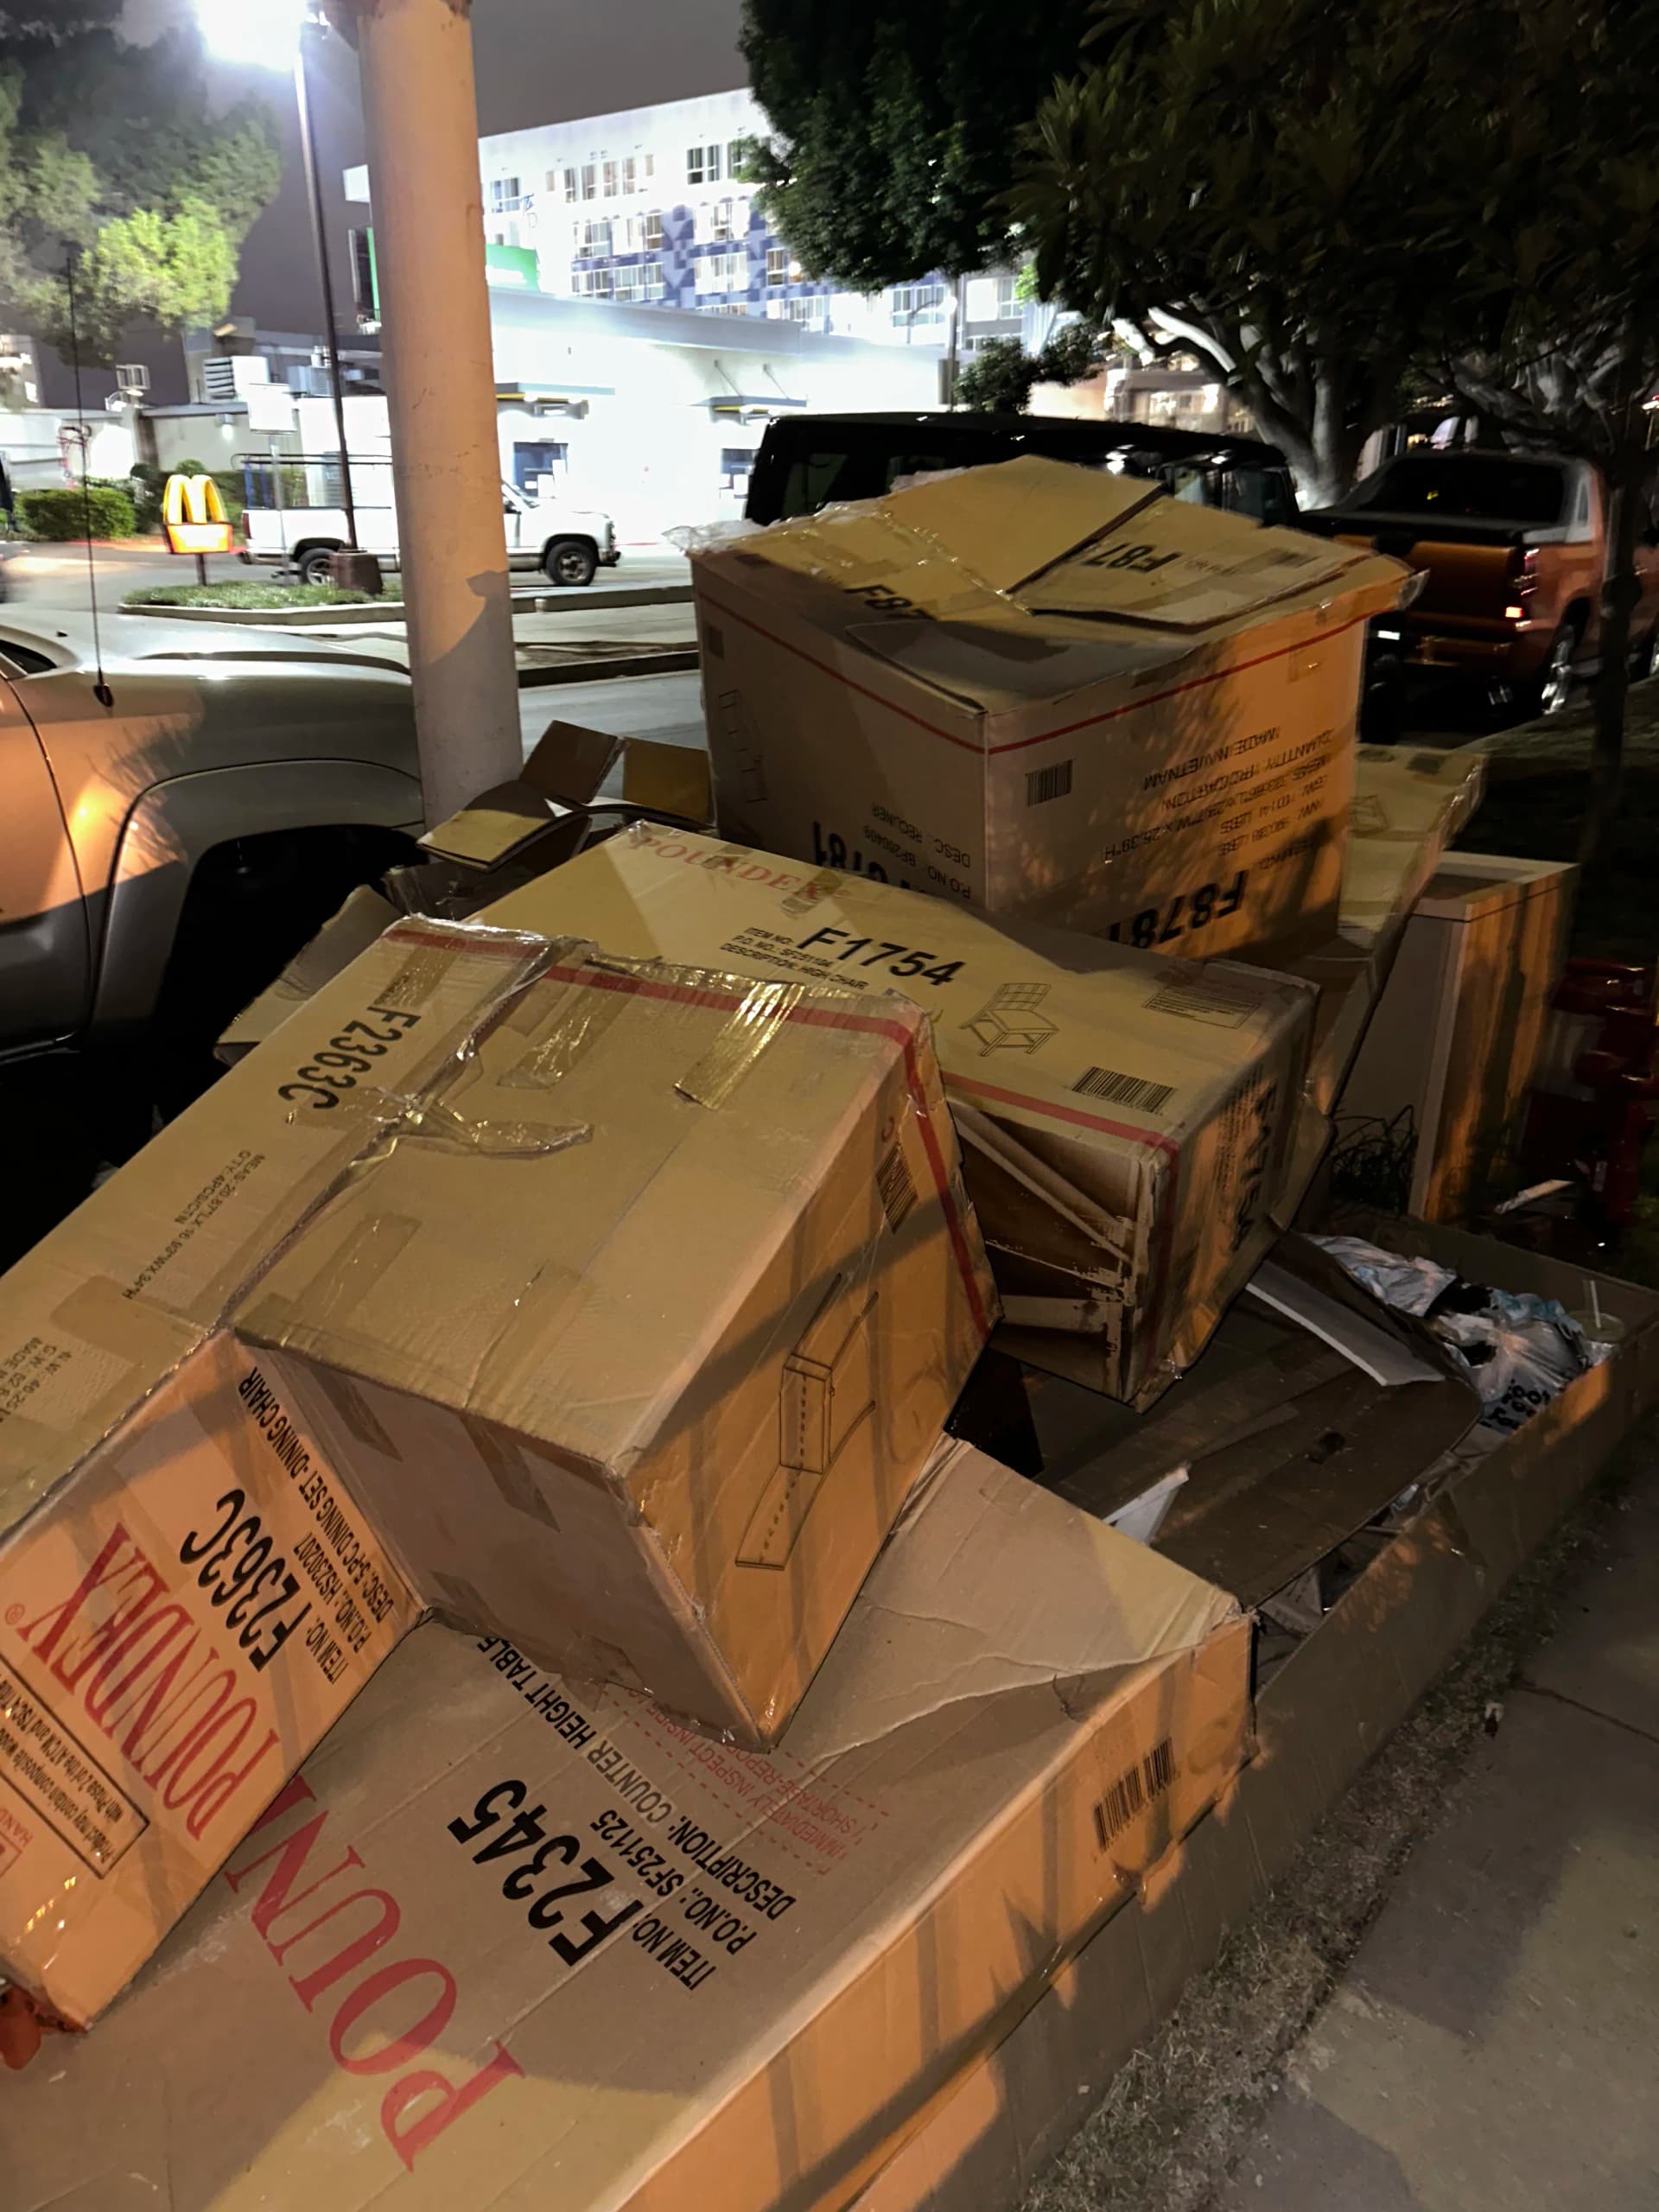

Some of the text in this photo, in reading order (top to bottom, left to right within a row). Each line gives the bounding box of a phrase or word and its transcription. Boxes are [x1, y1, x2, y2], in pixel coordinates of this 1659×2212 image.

[797, 926, 965, 987] F1754
[277, 1005, 422, 1111] F2363C
[235, 1366, 280, 1428] CHAIR
[298, 1471, 327, 1510] SET
[314, 1497, 354, 1553] DINING
[179, 1489, 348, 1684] ITEM NO: F2363C
[292, 1531, 344, 1605] HS230207
[20, 1522, 283, 1841] POUNDEX
[476, 1636, 798, 1922] DESCRIPTION: COUNTER HEIGHT TABLE
[692, 1744, 757, 1798] INSPECT
[447, 1778, 718, 1992] ITEM NO: F2345
[590, 1808, 685, 1898] SF251125
